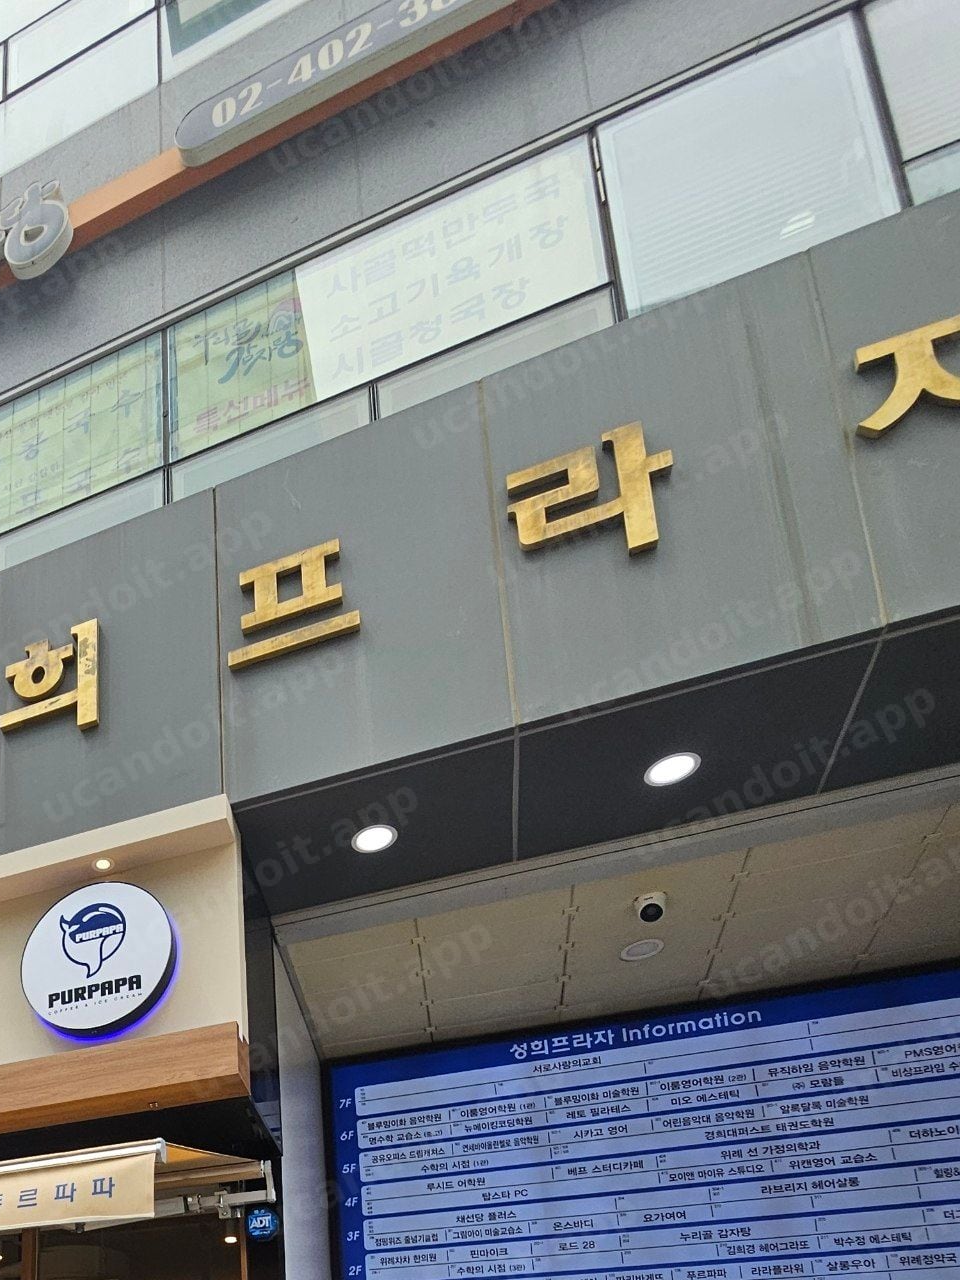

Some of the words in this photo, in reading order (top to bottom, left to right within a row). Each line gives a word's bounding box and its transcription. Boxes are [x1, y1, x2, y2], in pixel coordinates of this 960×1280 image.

[75, 923, 124, 943] PURPAPA
[48, 974, 142, 1009] PURPAPA
[509, 1028, 614, 1060] 성희프라자
[622, 1009, 762, 1042] Information
[905, 1043, 960, 1059] PMS영어
[533, 1055, 602, 1074] 서로사랑의교회
[768, 1063, 813, 1077] 뮤직하임
[817, 1056, 866, 1070] 음악학원
[892, 1063, 946, 1078] 비상프라임
[602, 1086, 639, 1099] 미술학원
[670, 1095, 692, 1106] 미오
[696, 1089, 740, 1103] 에스테틱
[340, 1098, 352, 1109] 7F
[825, 1094, 870, 1108] 미술학원
[590, 1103, 631, 1117] 필라테스
[715, 1108, 755, 1121] 음악학원
[409, 1113, 442, 1125] 음악학원
[340, 1130, 354, 1141] 6F
[574, 1127, 604, 1139] 시카고
[607, 1125, 628, 1135] 영어
[705, 1124, 770, 1140] 경희대퍼스트
[776, 1117, 834, 1132] 태권도학원
[720, 1149, 742, 1160] 위례
[747, 1146, 759, 1157] 선
[762, 1140, 820, 1156] 가정의학과
[371, 1152, 407, 1164] 공유오피스
[789, 1156, 835, 1170] 위캔영어
[841, 1152, 878, 1165] 교습소
[342, 1163, 356, 1174] 5F
[421, 1161, 448, 1173] 수학의
[452, 1159, 470, 1170] 시점
[567, 1166, 588, 1175] 베프
[592, 1160, 644, 1173] 스터디카페
[669, 1173, 695, 1182] 모이앤
[728, 1164, 765, 1176] 스튜디오
[426, 1181, 454, 1192] 루시드
[457, 1177, 486, 1189] 어학원
[761, 1182, 808, 1195] 라브리지
[811, 1177, 860, 1191] 헤어살롱
[345, 1197, 358, 1207] 4F
[482, 1190, 510, 1202] 탑스타
[514, 1189, 529, 1198] PC
[249, 1216, 271, 1229] ADT
[456, 1213, 485, 1224] 채선당
[488, 1210, 517, 1221] 플러스
[643, 1211, 687, 1223] 요가여여
[347, 1231, 360, 1241] 3F
[452, 1228, 483, 1240] 그림아이
[485, 1225, 523, 1237] 미술교습소
[680, 1230, 713, 1242] 누리골
[717, 1226, 751, 1238] 감자탕
[833, 1235, 866, 1246] 박수정
[869, 1231, 913, 1245] 에스테틱
[558, 1241, 580, 1252] 로드
[582, 1240, 595, 1249] 28
[759, 1239, 810, 1252] 헤어그라또
[380, 1254, 410, 1266] 위례차차
[413, 1253, 437, 1263] 한의원
[826, 1258, 876, 1272] 살롱우아
[348, 1265, 362, 1276] 2F
[457, 1264, 484, 1276] 수학의
[488, 1263, 506, 1274] 시점
[686, 1268, 727, 1280] 푸르파파
[751, 1263, 804, 1276] 라라플라워
